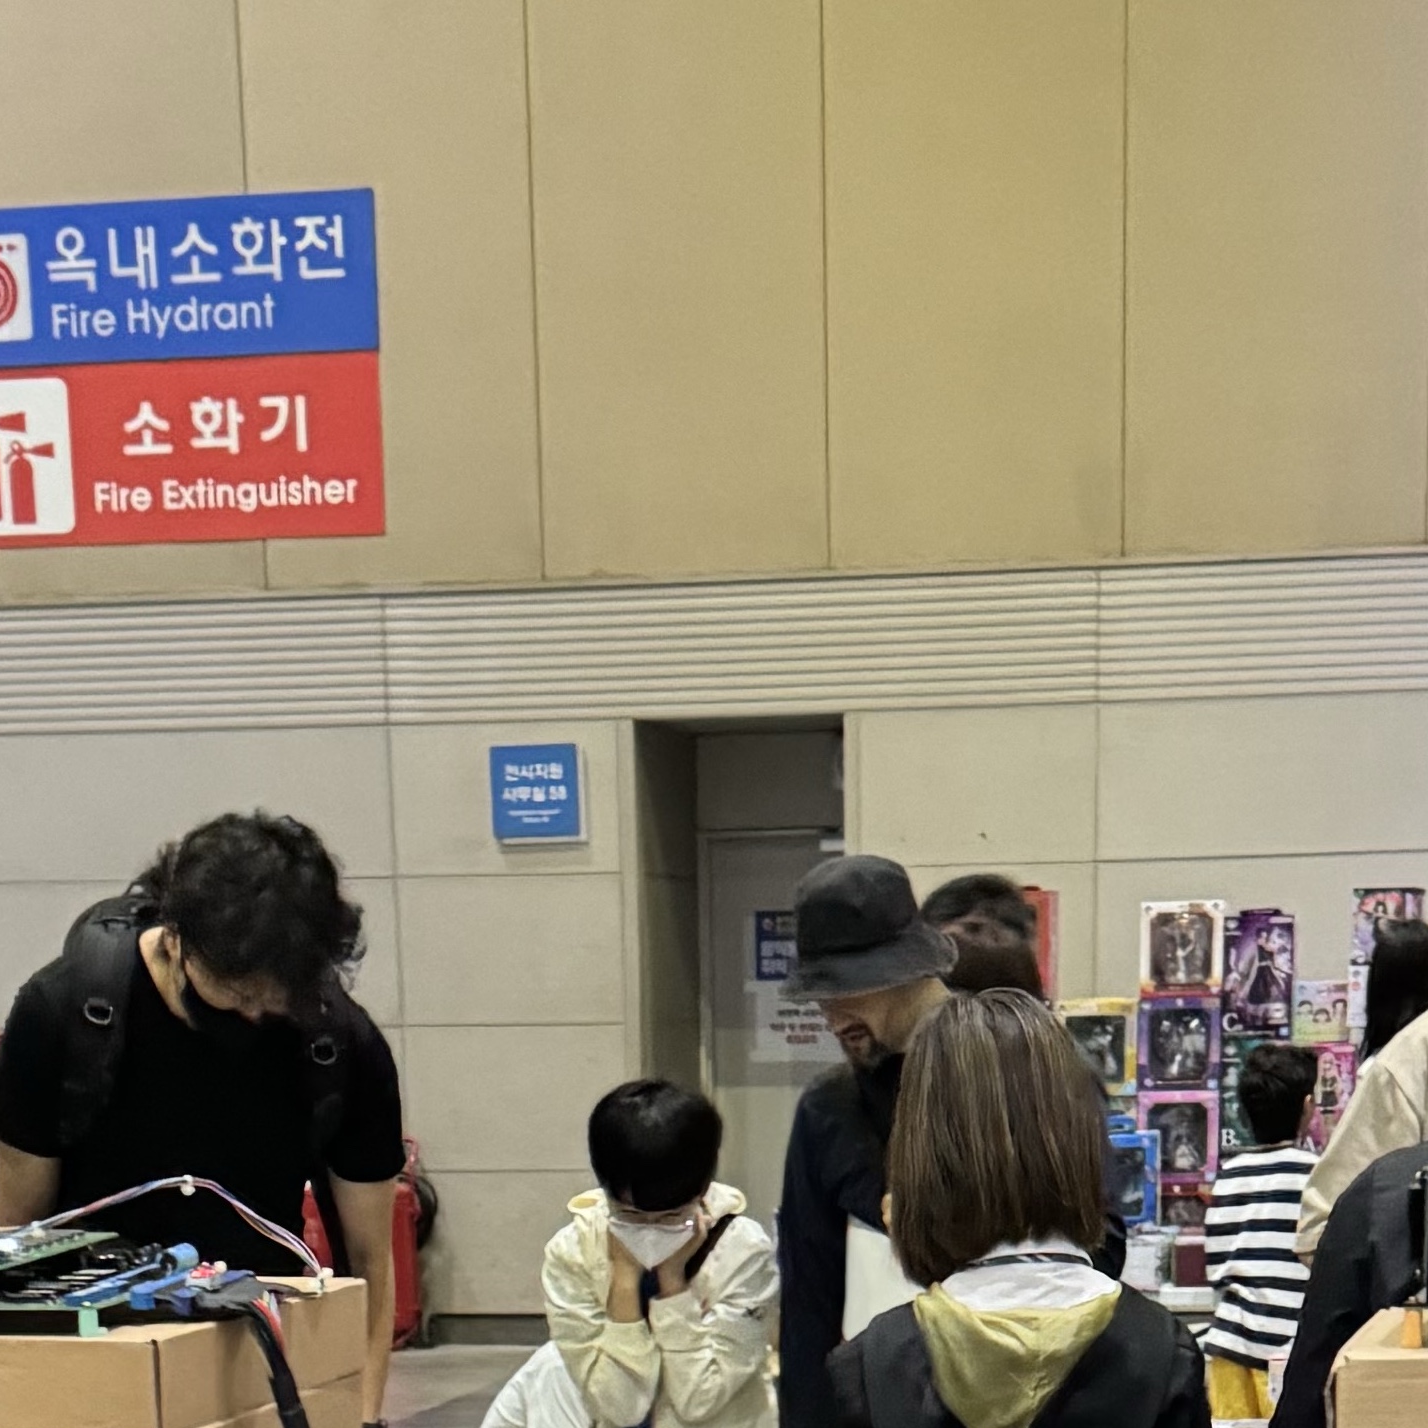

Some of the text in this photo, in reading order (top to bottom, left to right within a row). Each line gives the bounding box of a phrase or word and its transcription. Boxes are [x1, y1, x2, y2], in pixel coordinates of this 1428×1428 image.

[46, 215, 346, 292] 옥내소화전
[51, 292, 275, 340] Fire Hydrant
[122, 395, 308, 456] 소화기
[94, 475, 358, 513] Fire Extinguisher
